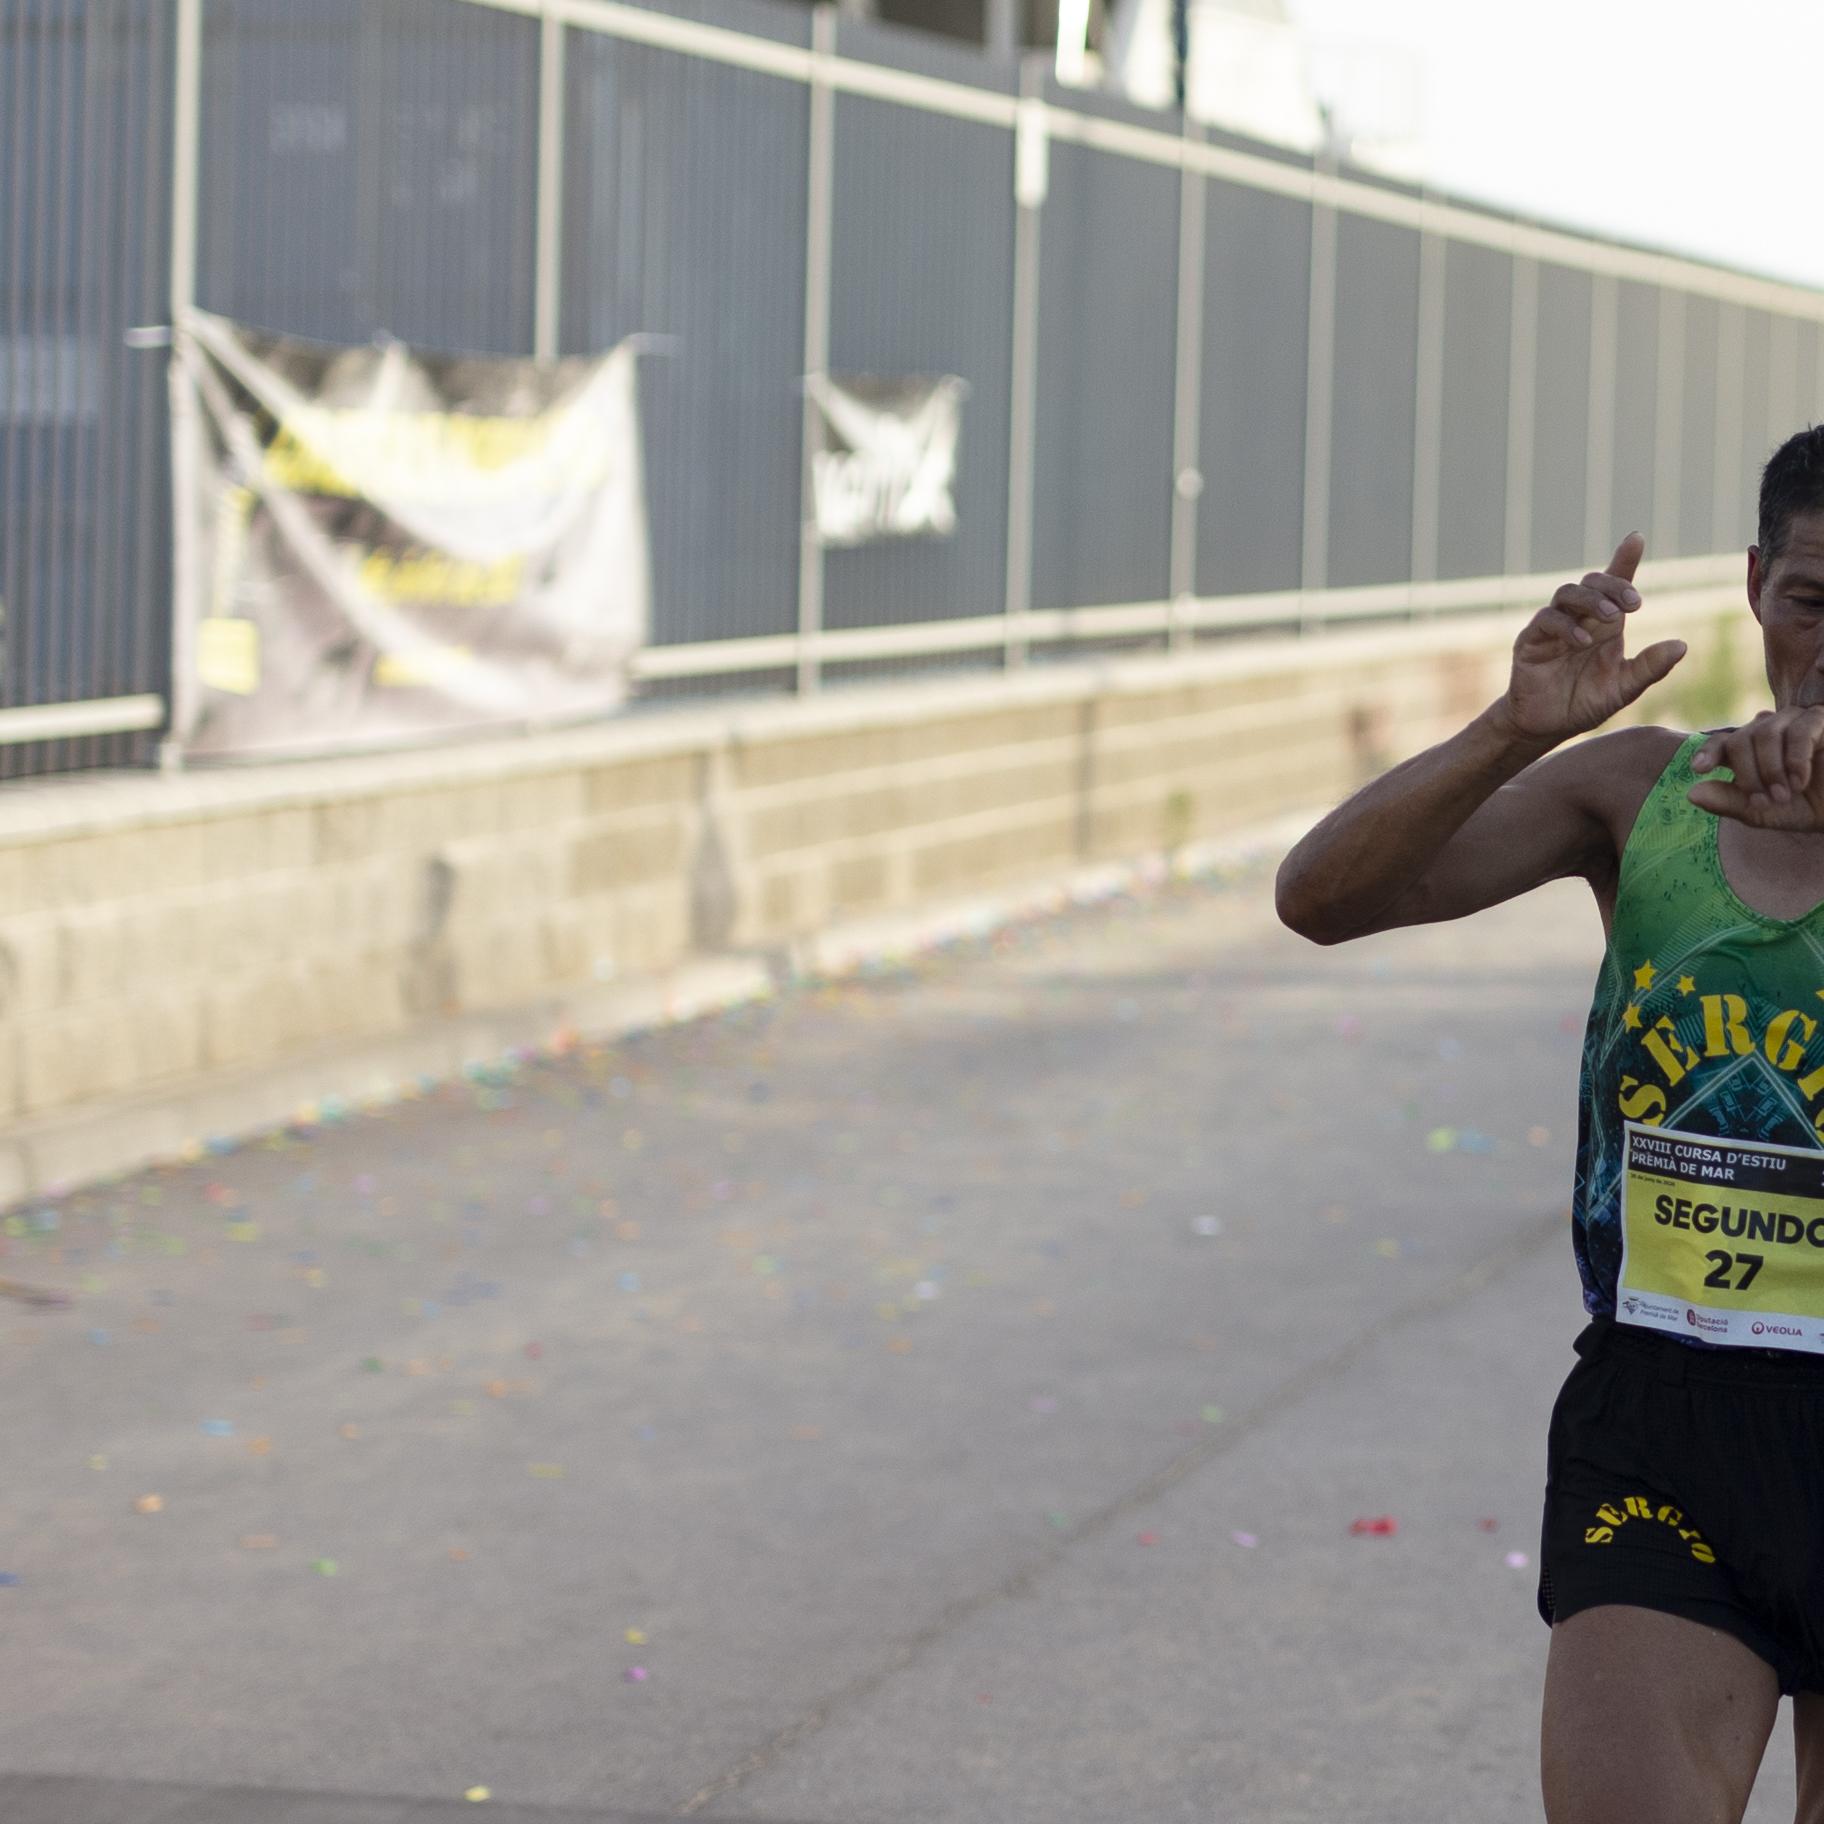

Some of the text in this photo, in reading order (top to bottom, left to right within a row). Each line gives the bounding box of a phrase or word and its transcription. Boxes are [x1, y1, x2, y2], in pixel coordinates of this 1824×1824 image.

[1632, 1135, 1672, 1155] XXVIII
[1674, 1144, 1722, 1163] CURSA
[1680, 1161, 1697, 1176] DE
[1701, 1164, 1735, 1181] MAR
[1703, 1249, 1764, 1291] 27
[1766, 1324, 1803, 1337] VEOLIA
[1585, 1496, 1716, 1564] SERGIO
